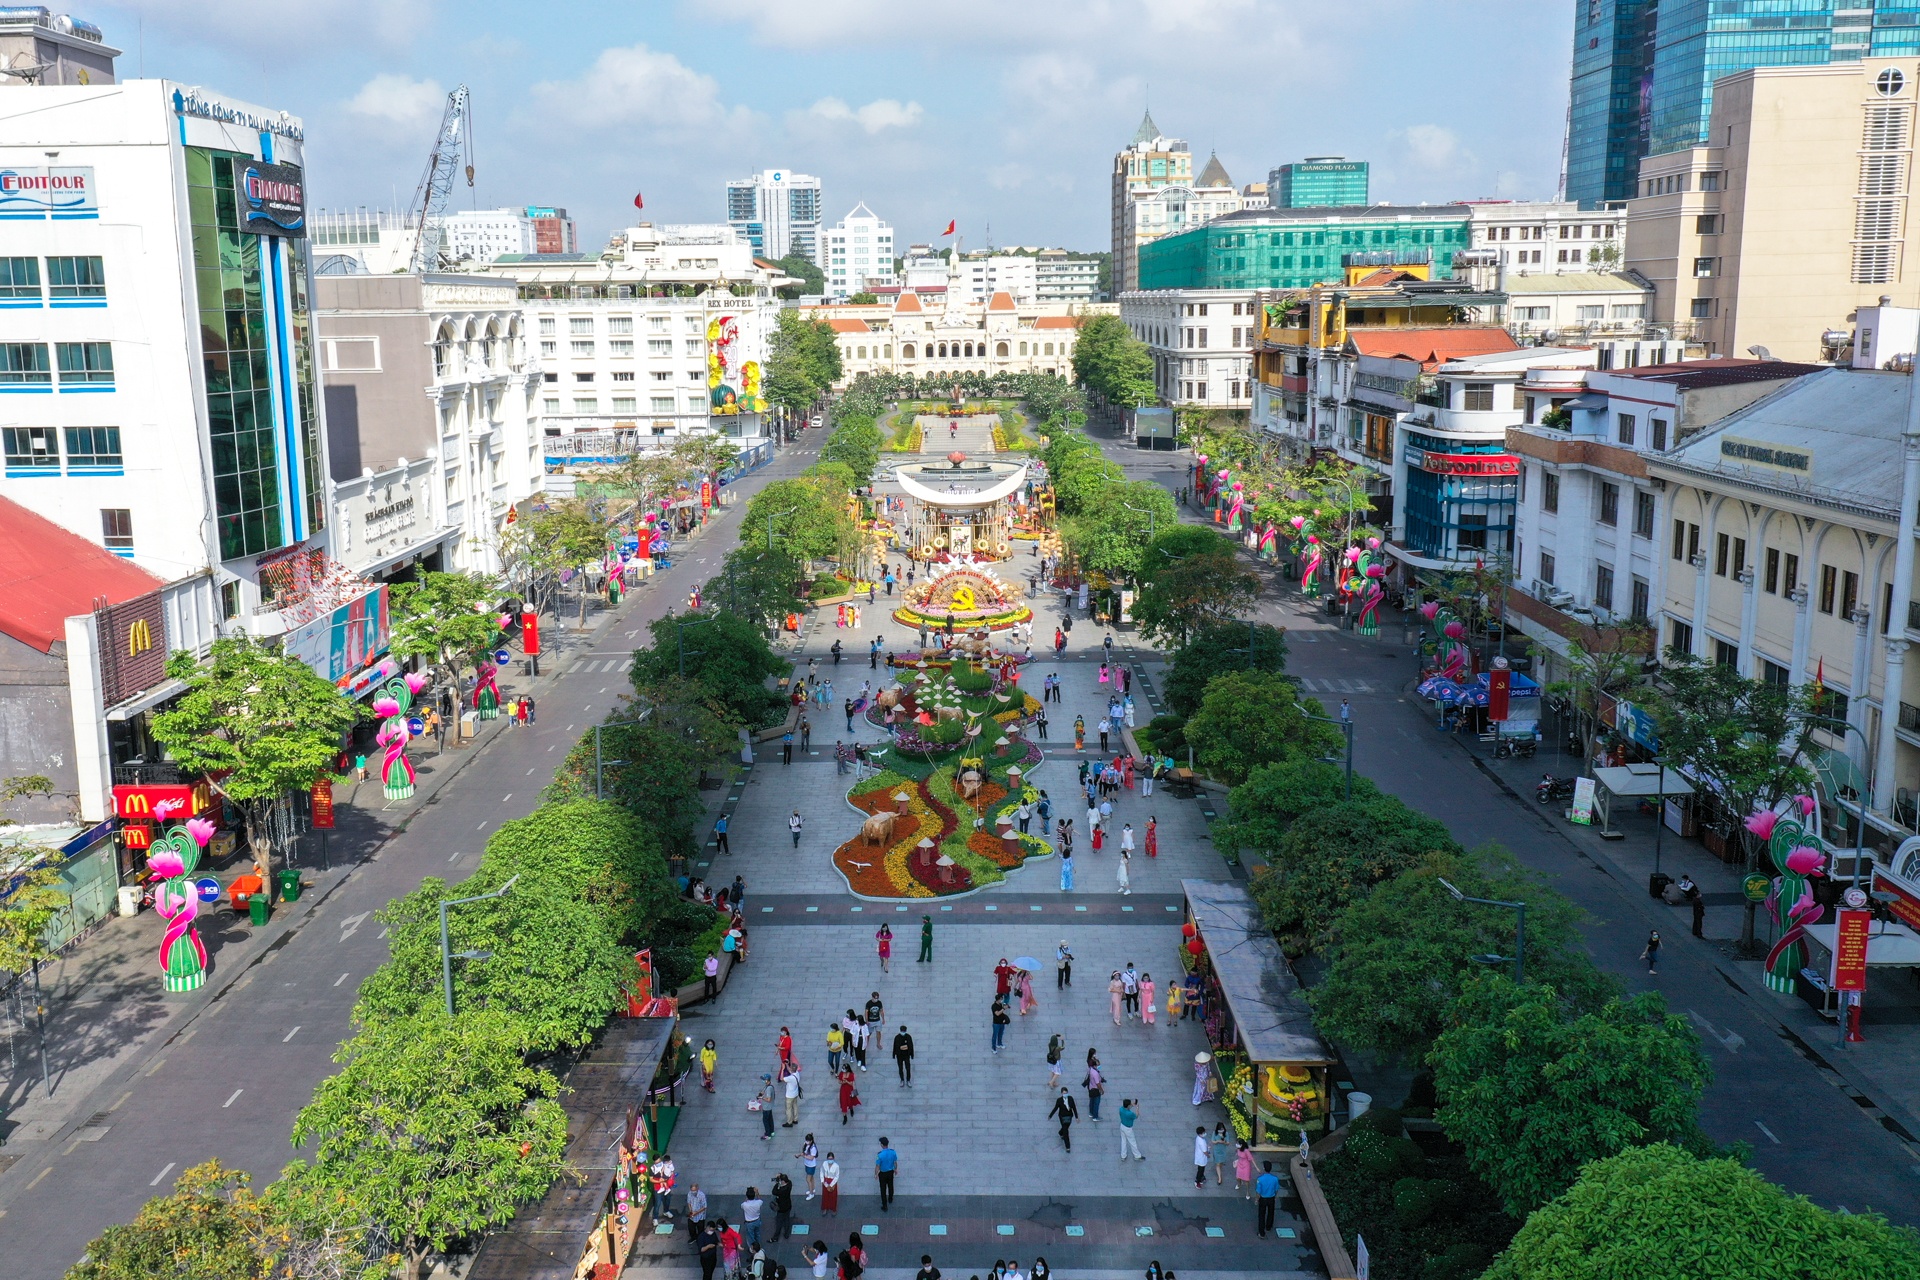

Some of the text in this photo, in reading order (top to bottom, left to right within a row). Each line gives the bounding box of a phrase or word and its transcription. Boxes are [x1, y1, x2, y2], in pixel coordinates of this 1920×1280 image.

[3, 176, 85, 190] FIDITOUR
[707, 299, 754, 308] REX HOTEL
[1511, 689, 1531, 697] pepsi
